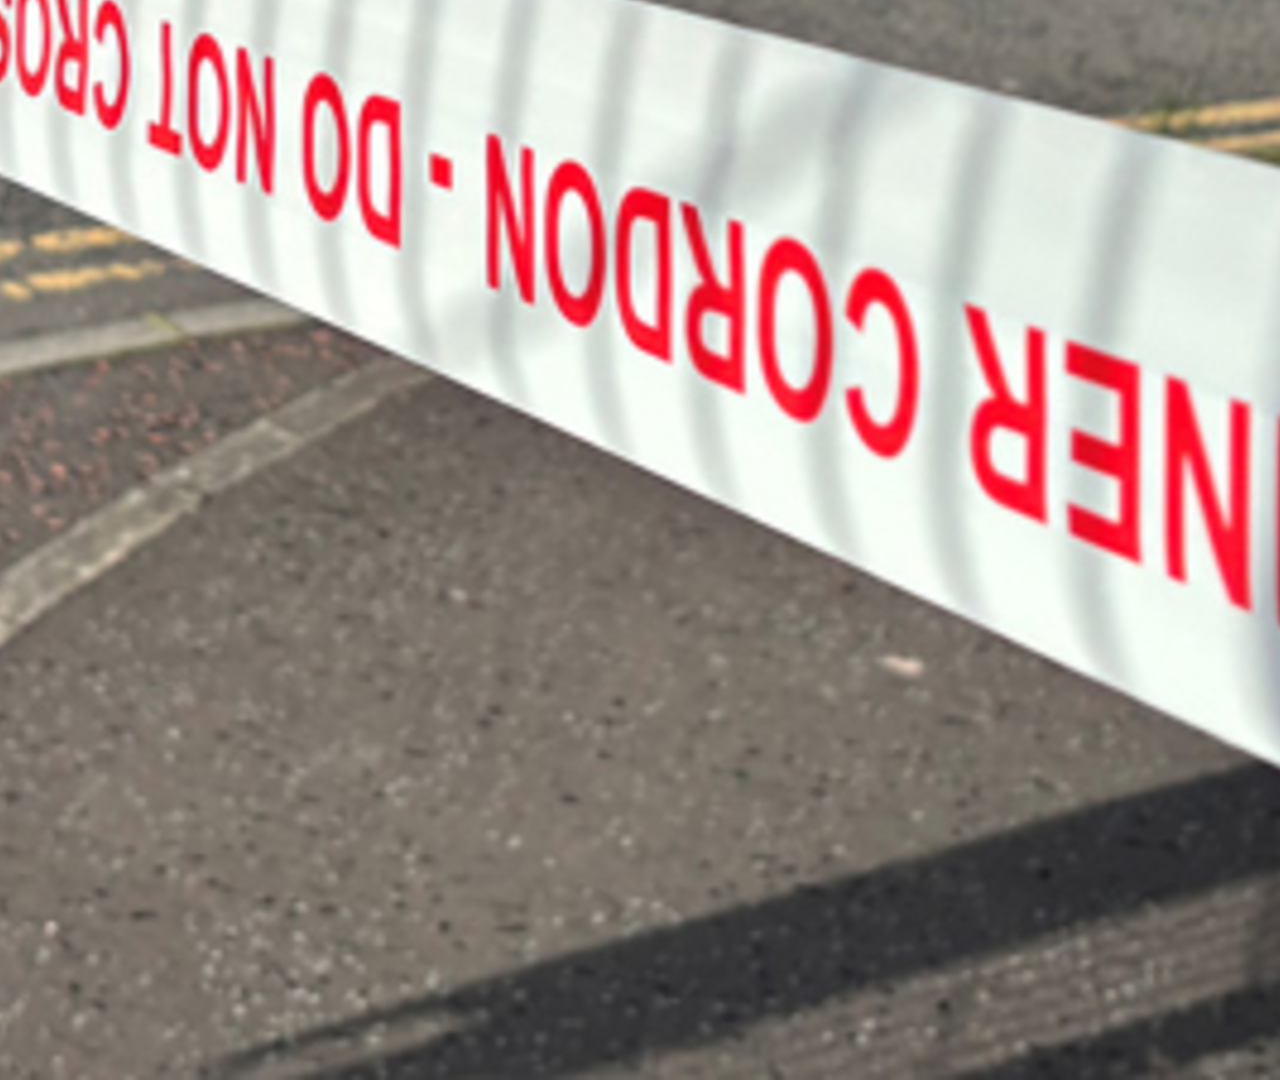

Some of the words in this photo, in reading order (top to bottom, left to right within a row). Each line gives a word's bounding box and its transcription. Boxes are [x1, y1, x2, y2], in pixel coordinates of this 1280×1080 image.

[147, 21, 277, 196] NOT
[301, 71, 403, 250] DO
[485, 133, 921, 460] CORDON
